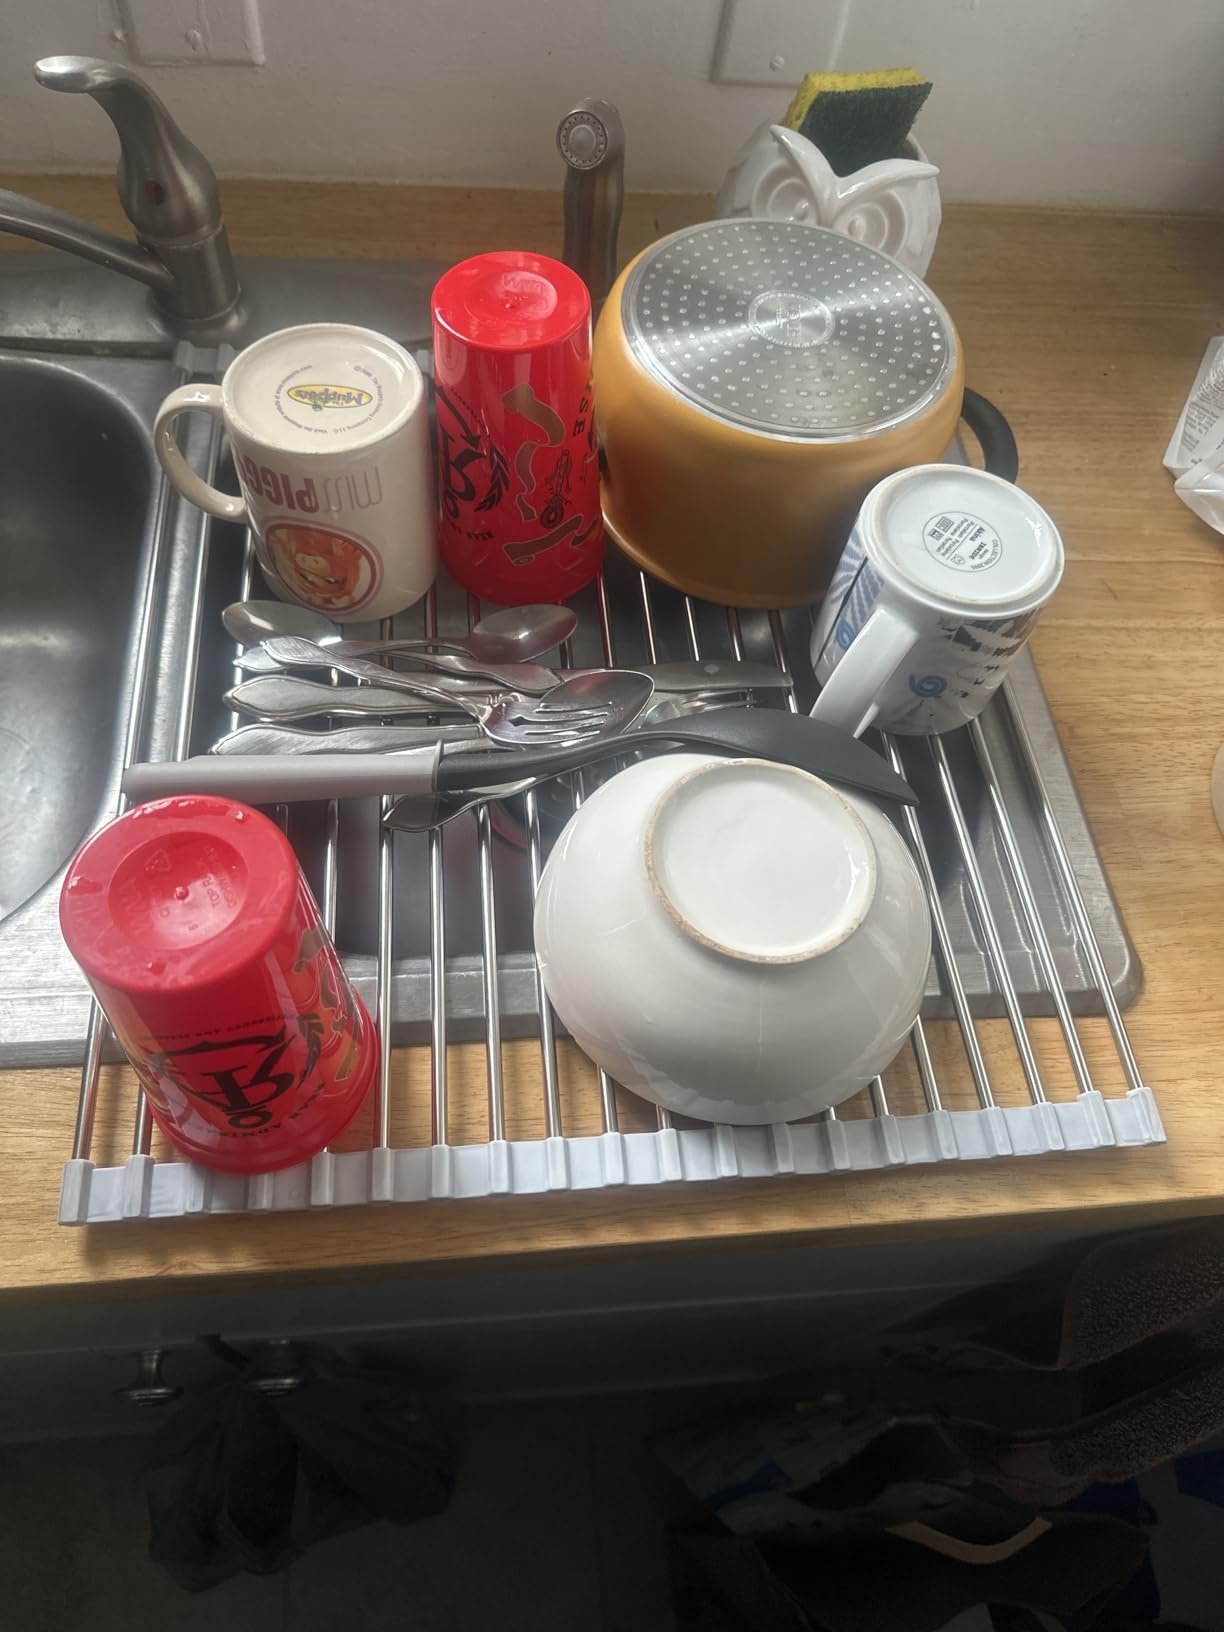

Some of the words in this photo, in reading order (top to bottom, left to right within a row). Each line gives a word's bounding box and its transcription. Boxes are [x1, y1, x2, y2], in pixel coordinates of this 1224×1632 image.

[294, 388, 364, 405] Muppets
[969, 526, 985, 542] Akina
[983, 539, 999, 565] COLLECTION
